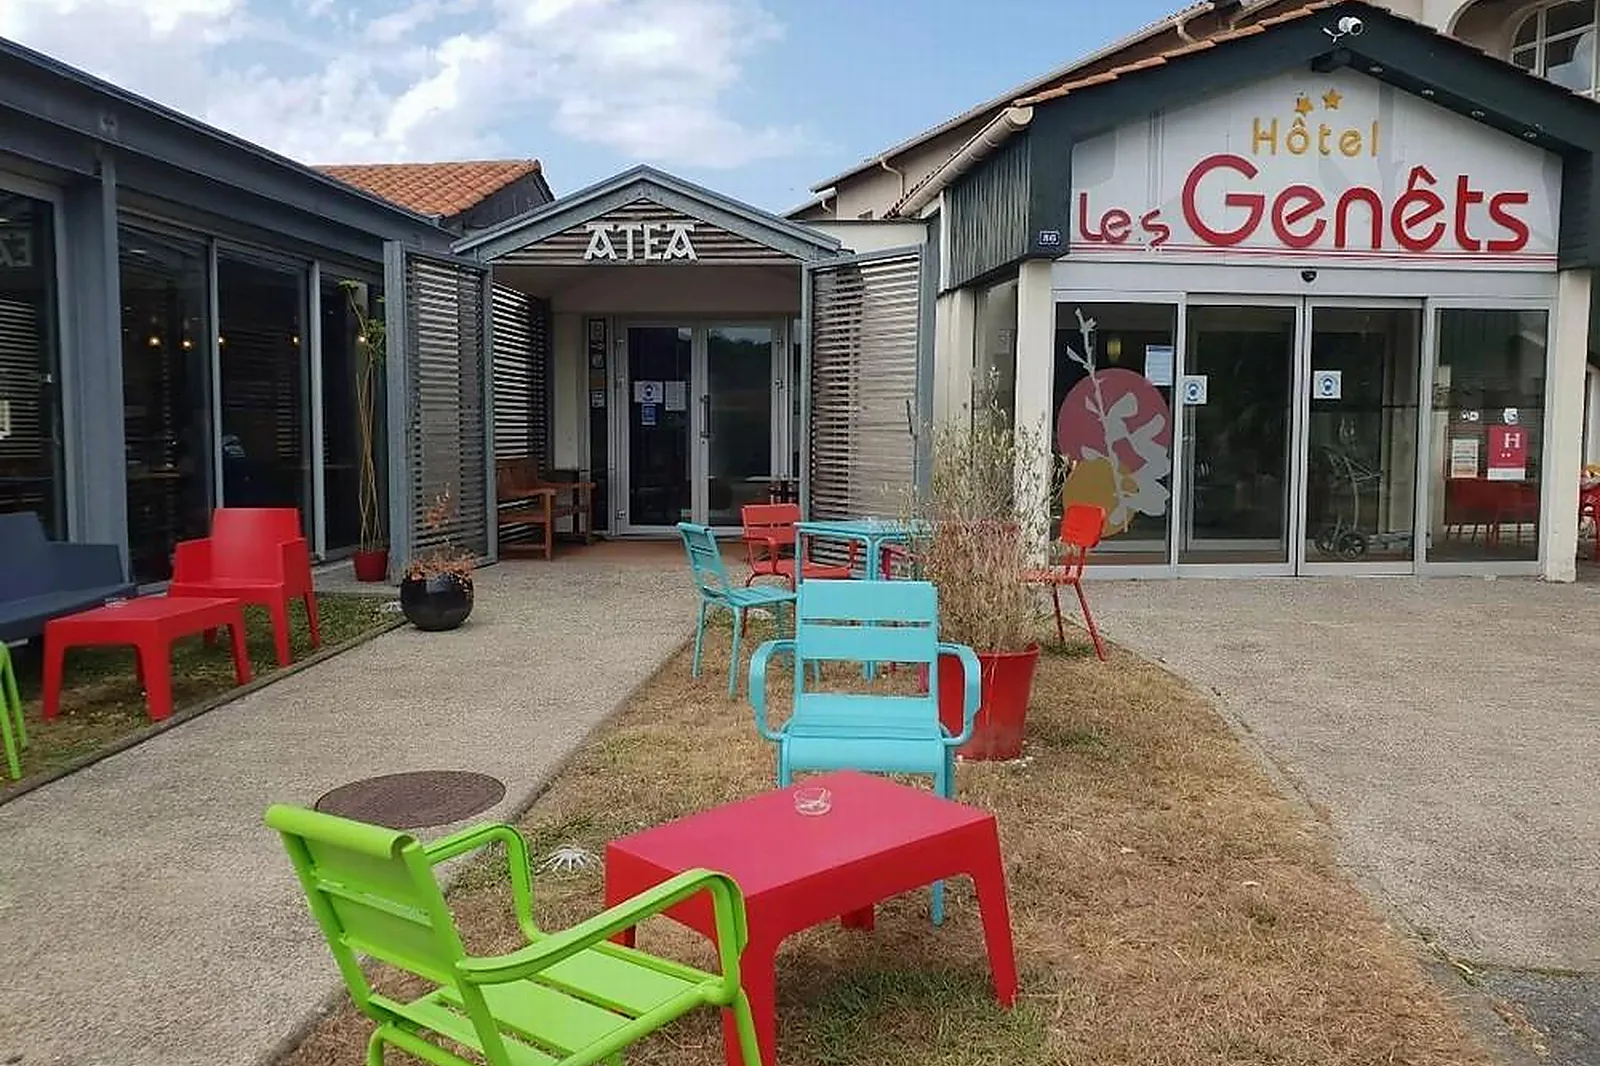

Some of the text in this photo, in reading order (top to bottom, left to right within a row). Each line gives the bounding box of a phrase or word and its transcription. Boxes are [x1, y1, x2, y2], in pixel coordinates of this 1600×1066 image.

[1253, 116, 1379, 157] Hôtel
[1182, 153, 1529, 252] Genêts
[584, 223, 698, 260] ATEA
[1504, 432, 1521, 448] H
